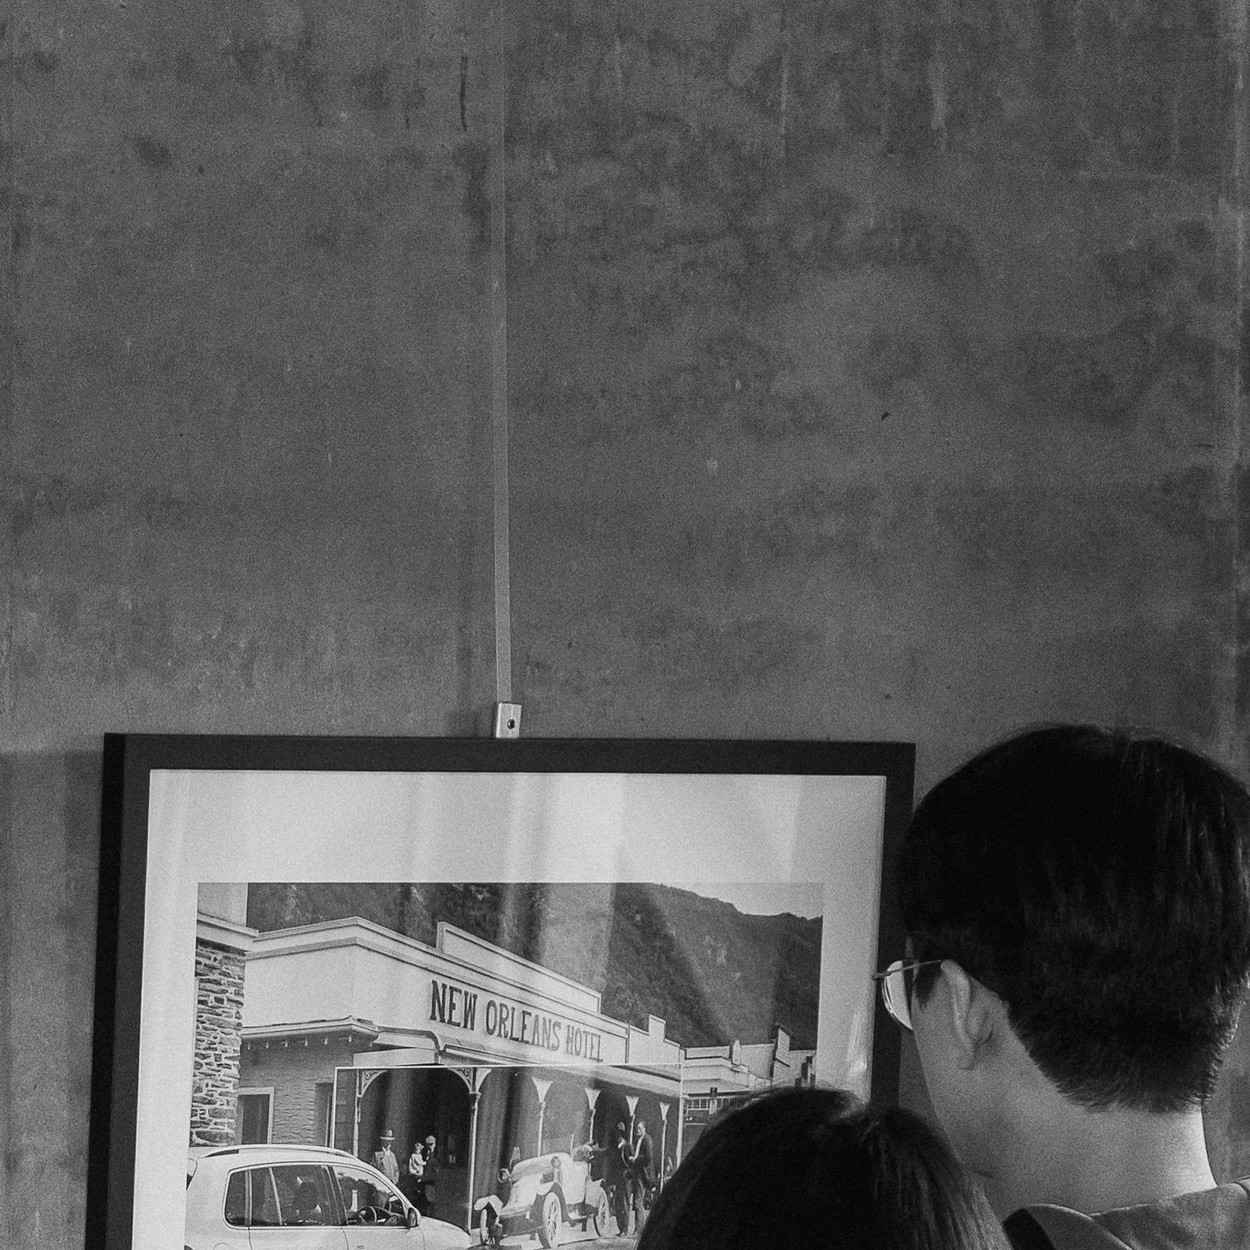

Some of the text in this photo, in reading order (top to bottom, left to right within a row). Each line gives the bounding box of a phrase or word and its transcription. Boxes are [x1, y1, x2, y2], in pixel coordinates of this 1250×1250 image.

[430, 980, 603, 1062] NEW ORLEANS HOTEL
